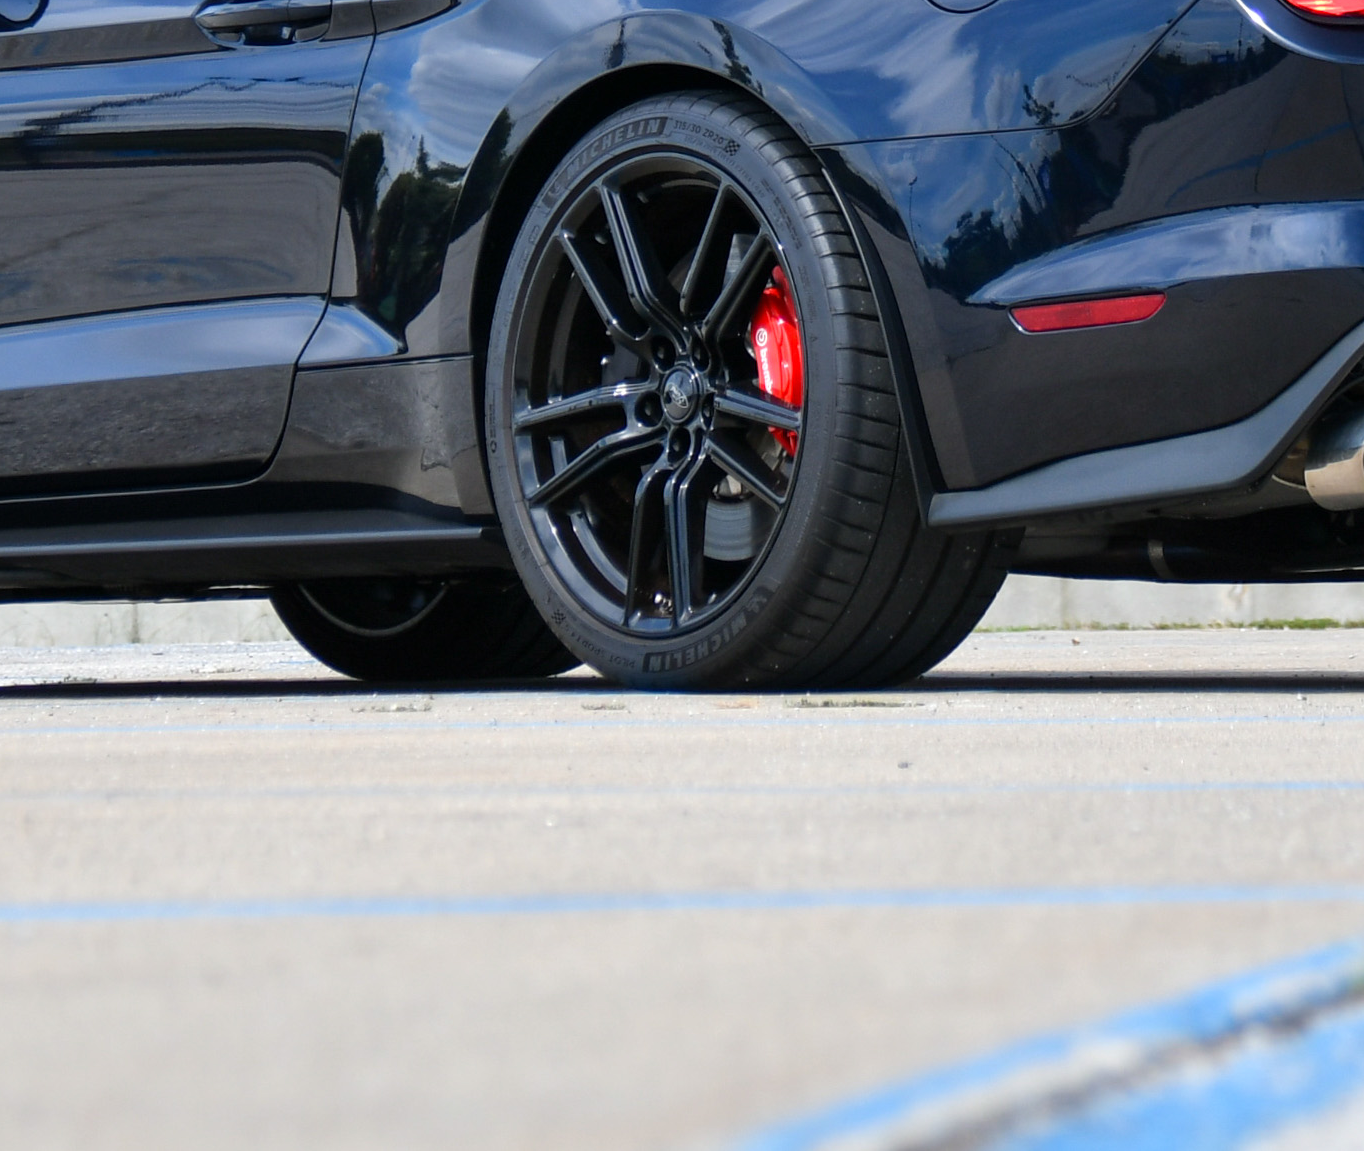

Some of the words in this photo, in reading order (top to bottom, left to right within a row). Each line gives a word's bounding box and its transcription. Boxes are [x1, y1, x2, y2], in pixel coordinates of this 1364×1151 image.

[565, 118, 662, 180] MICHELIN
[702, 128, 725, 145] ZR20
[759, 347, 773, 395] bremb
[648, 612, 747, 671] MICHELIN
